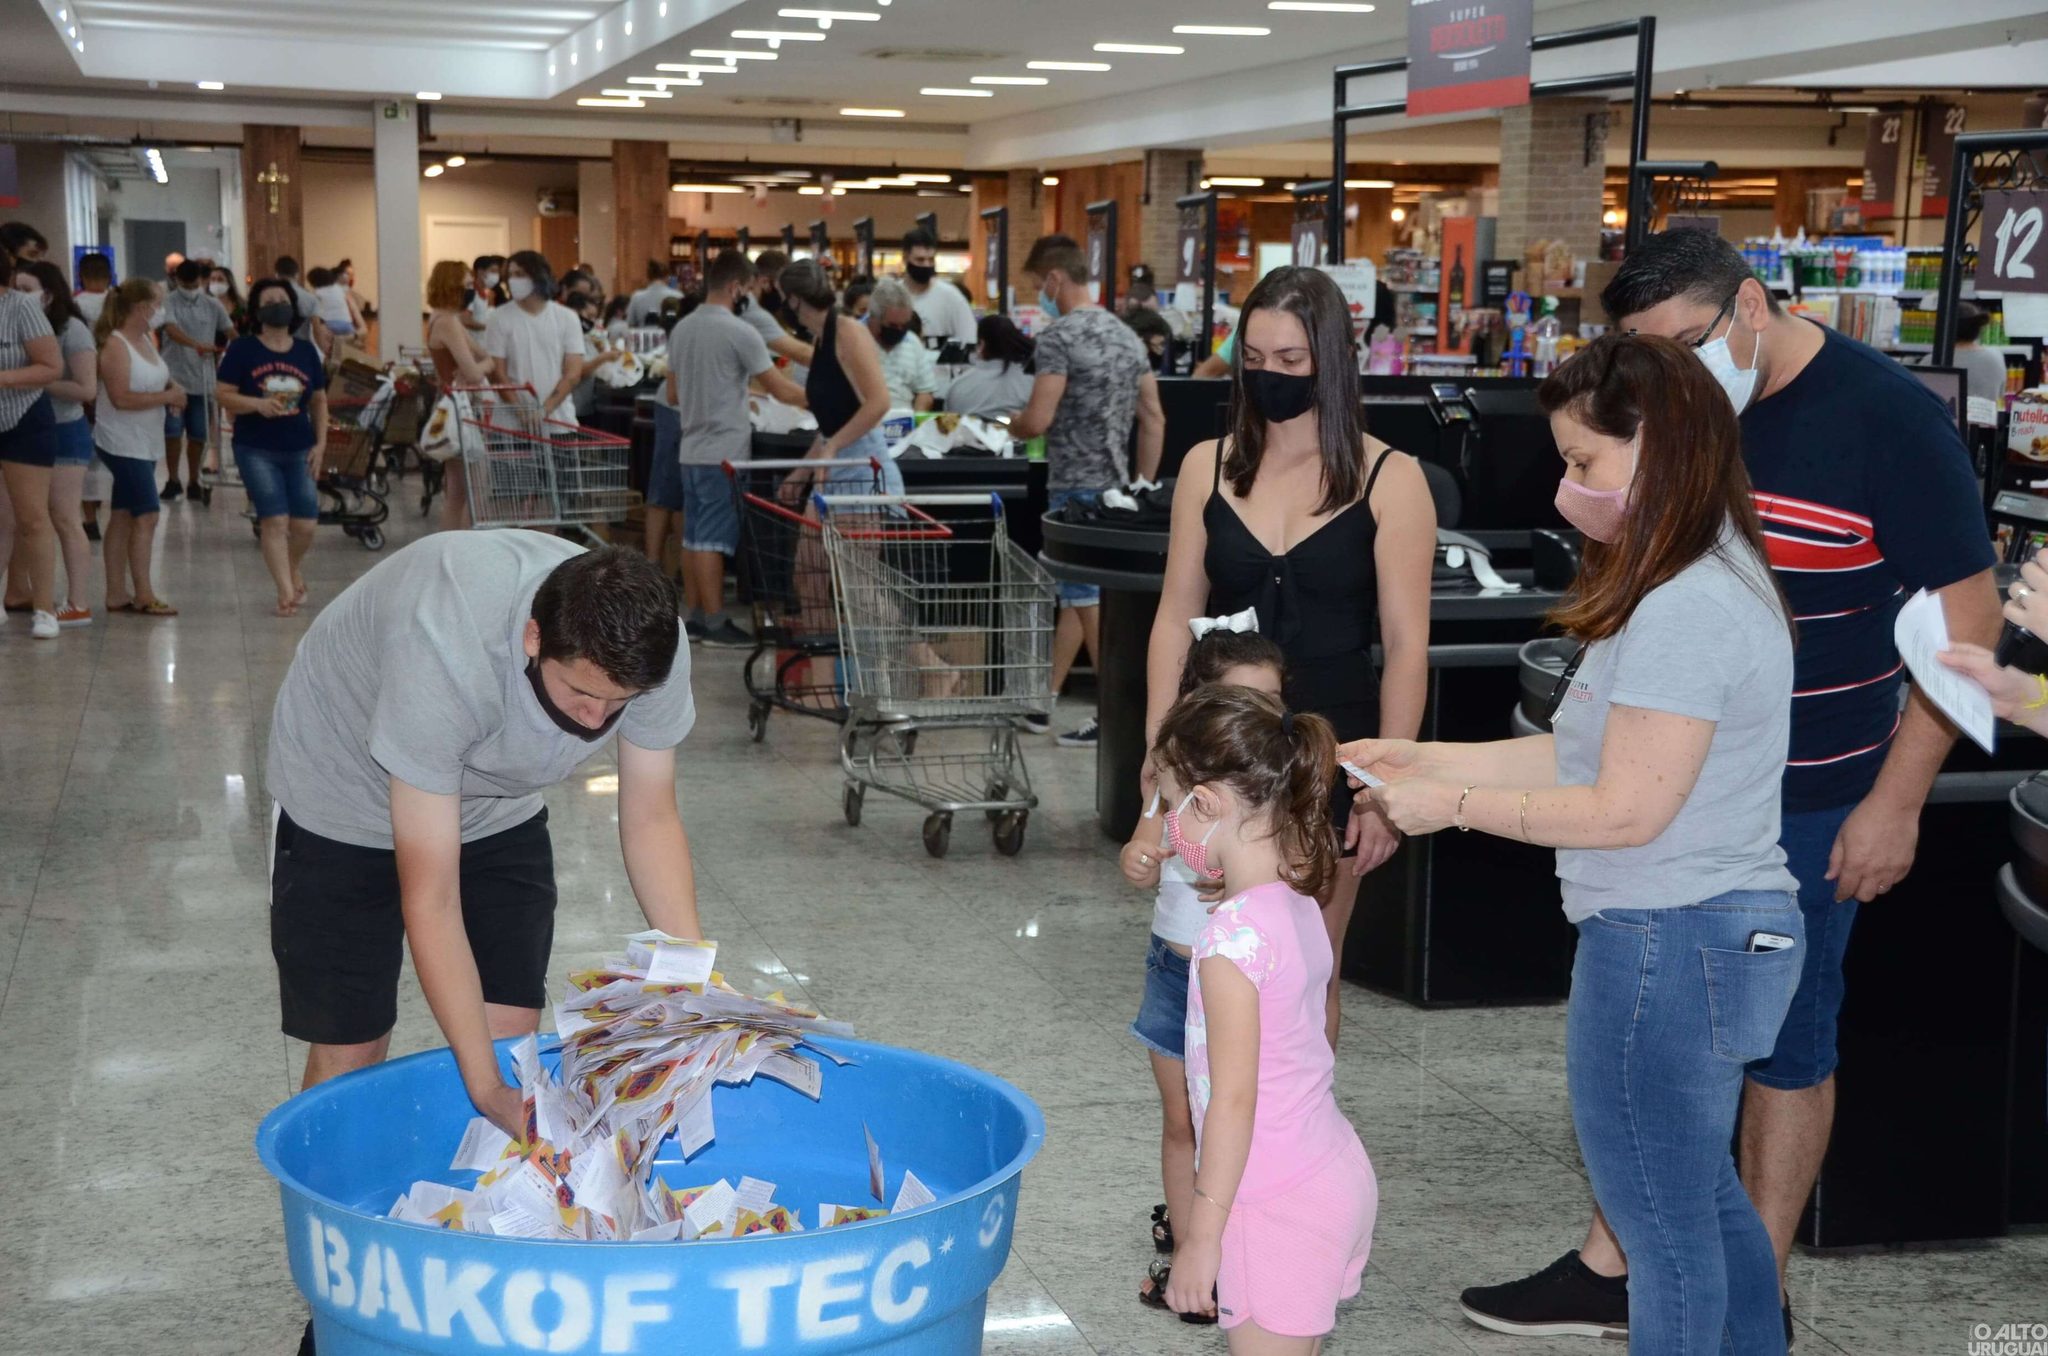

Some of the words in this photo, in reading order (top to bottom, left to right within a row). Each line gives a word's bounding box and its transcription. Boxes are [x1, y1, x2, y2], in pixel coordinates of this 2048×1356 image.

[1449, 4, 1486, 23] SUPER
[1881, 117, 1900, 144] 23
[1943, 107, 1965, 135] 22
[1182, 236, 1196, 277] 9
[1993, 206, 2044, 280] 12
[2013, 407, 2048, 425] nutella
[307, 1214, 677, 1353] BAKOF
[714, 1238, 931, 1349] TEC
